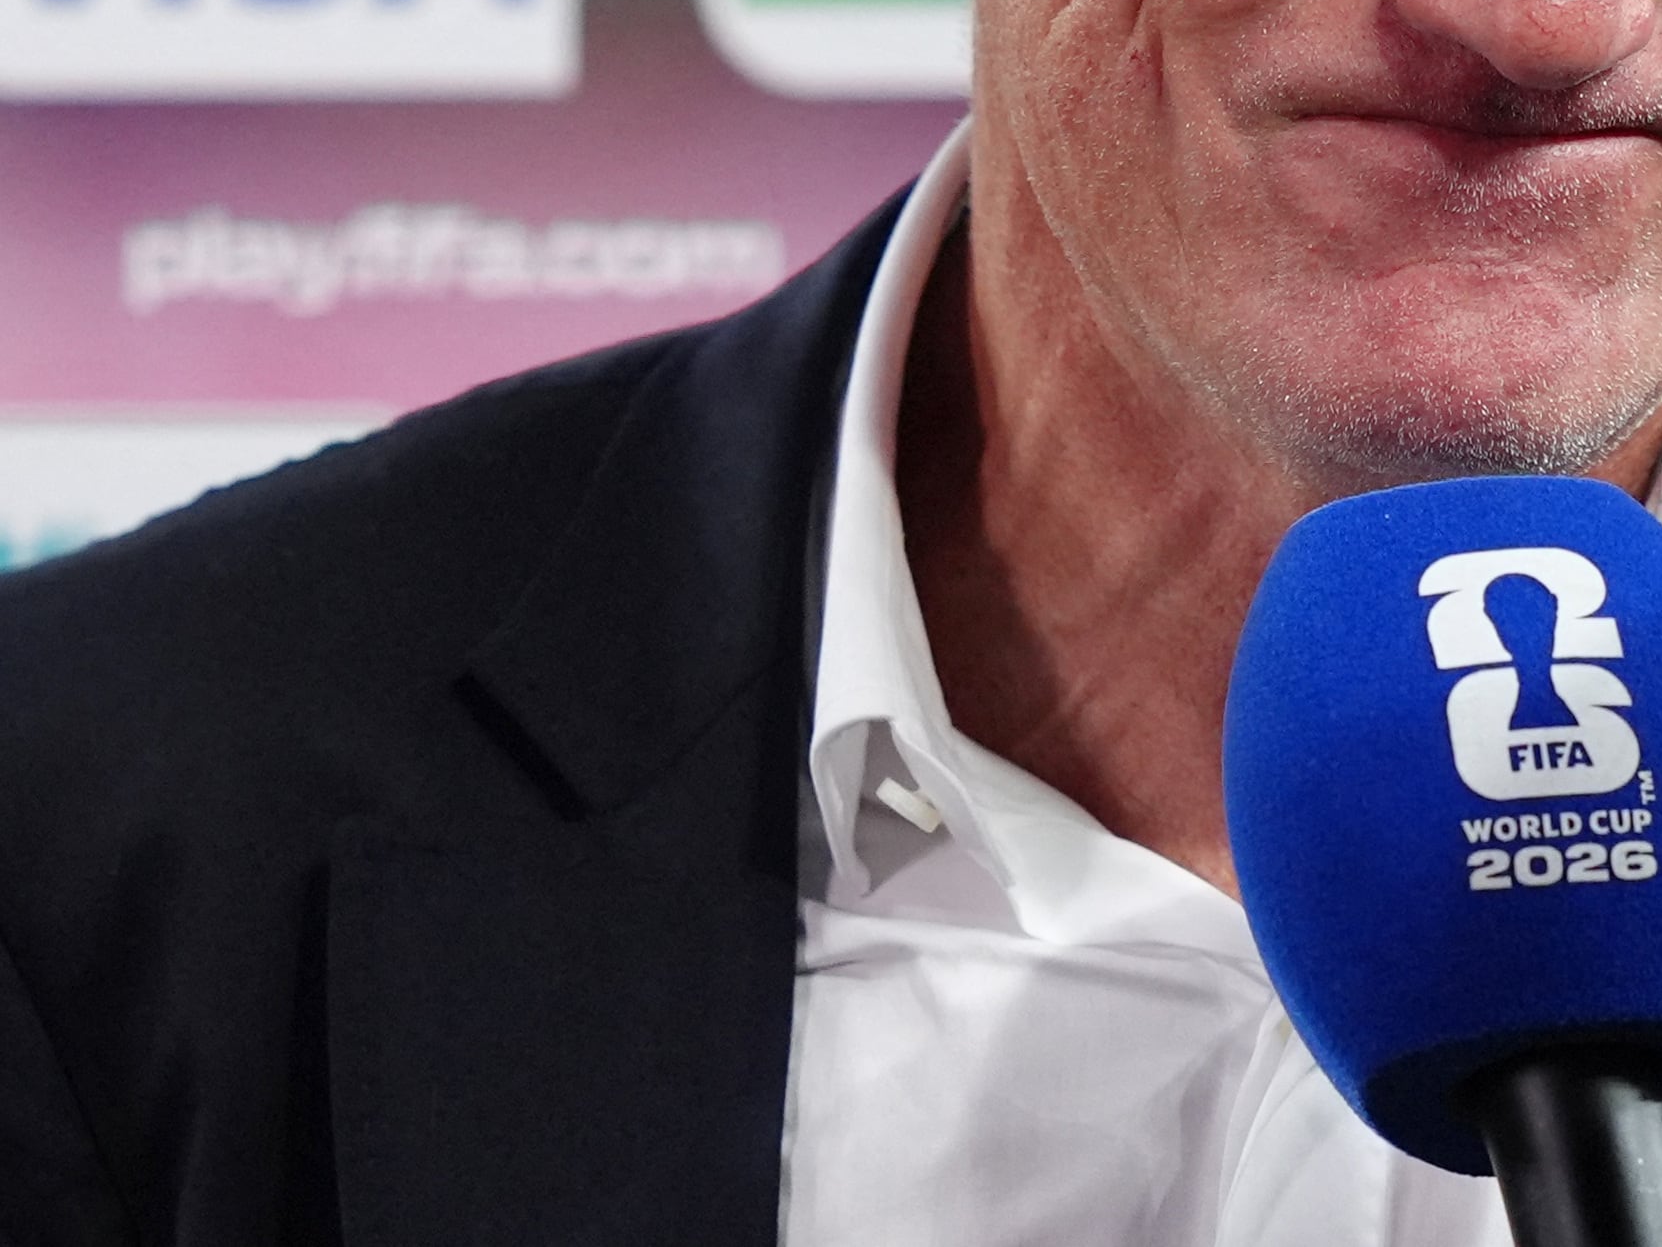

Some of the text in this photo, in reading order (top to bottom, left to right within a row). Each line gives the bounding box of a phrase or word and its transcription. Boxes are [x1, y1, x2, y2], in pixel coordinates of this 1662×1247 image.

[1508, 741, 1594, 772] FIFA
[1461, 808, 1652, 844] WORLD CUP
[1466, 840, 1658, 891] 2026
